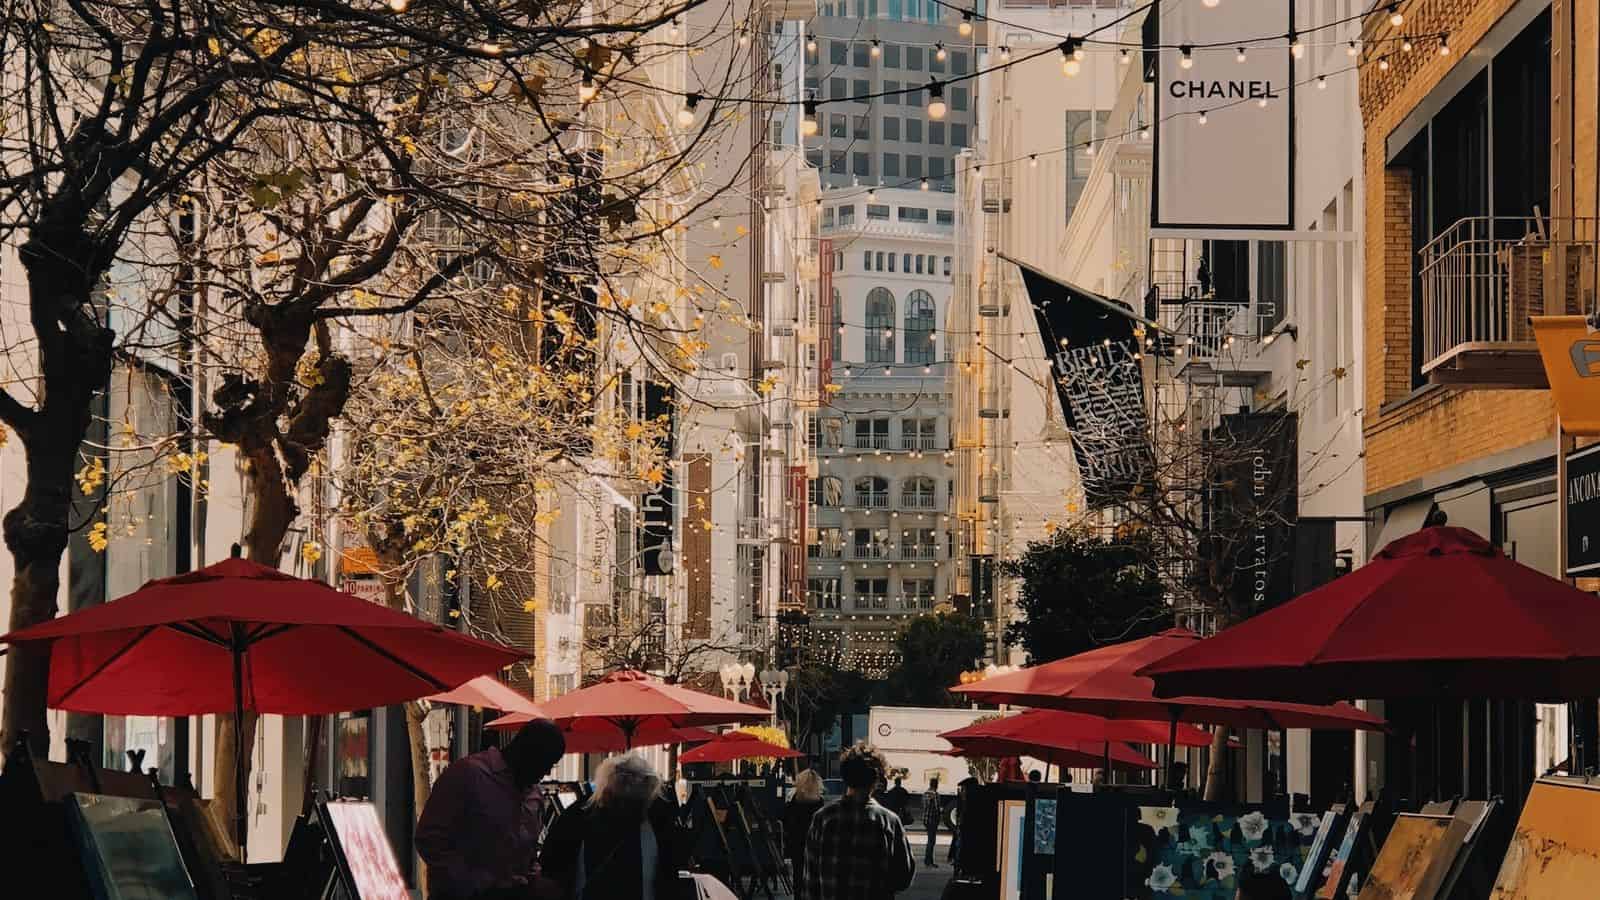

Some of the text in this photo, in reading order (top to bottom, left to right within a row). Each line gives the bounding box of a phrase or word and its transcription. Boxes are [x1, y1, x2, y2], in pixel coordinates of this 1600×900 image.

[1169, 80, 1278, 99] CHANEL
[1056, 338, 1135, 375] BRITEX
[1253, 505, 1267, 602] rvatos
